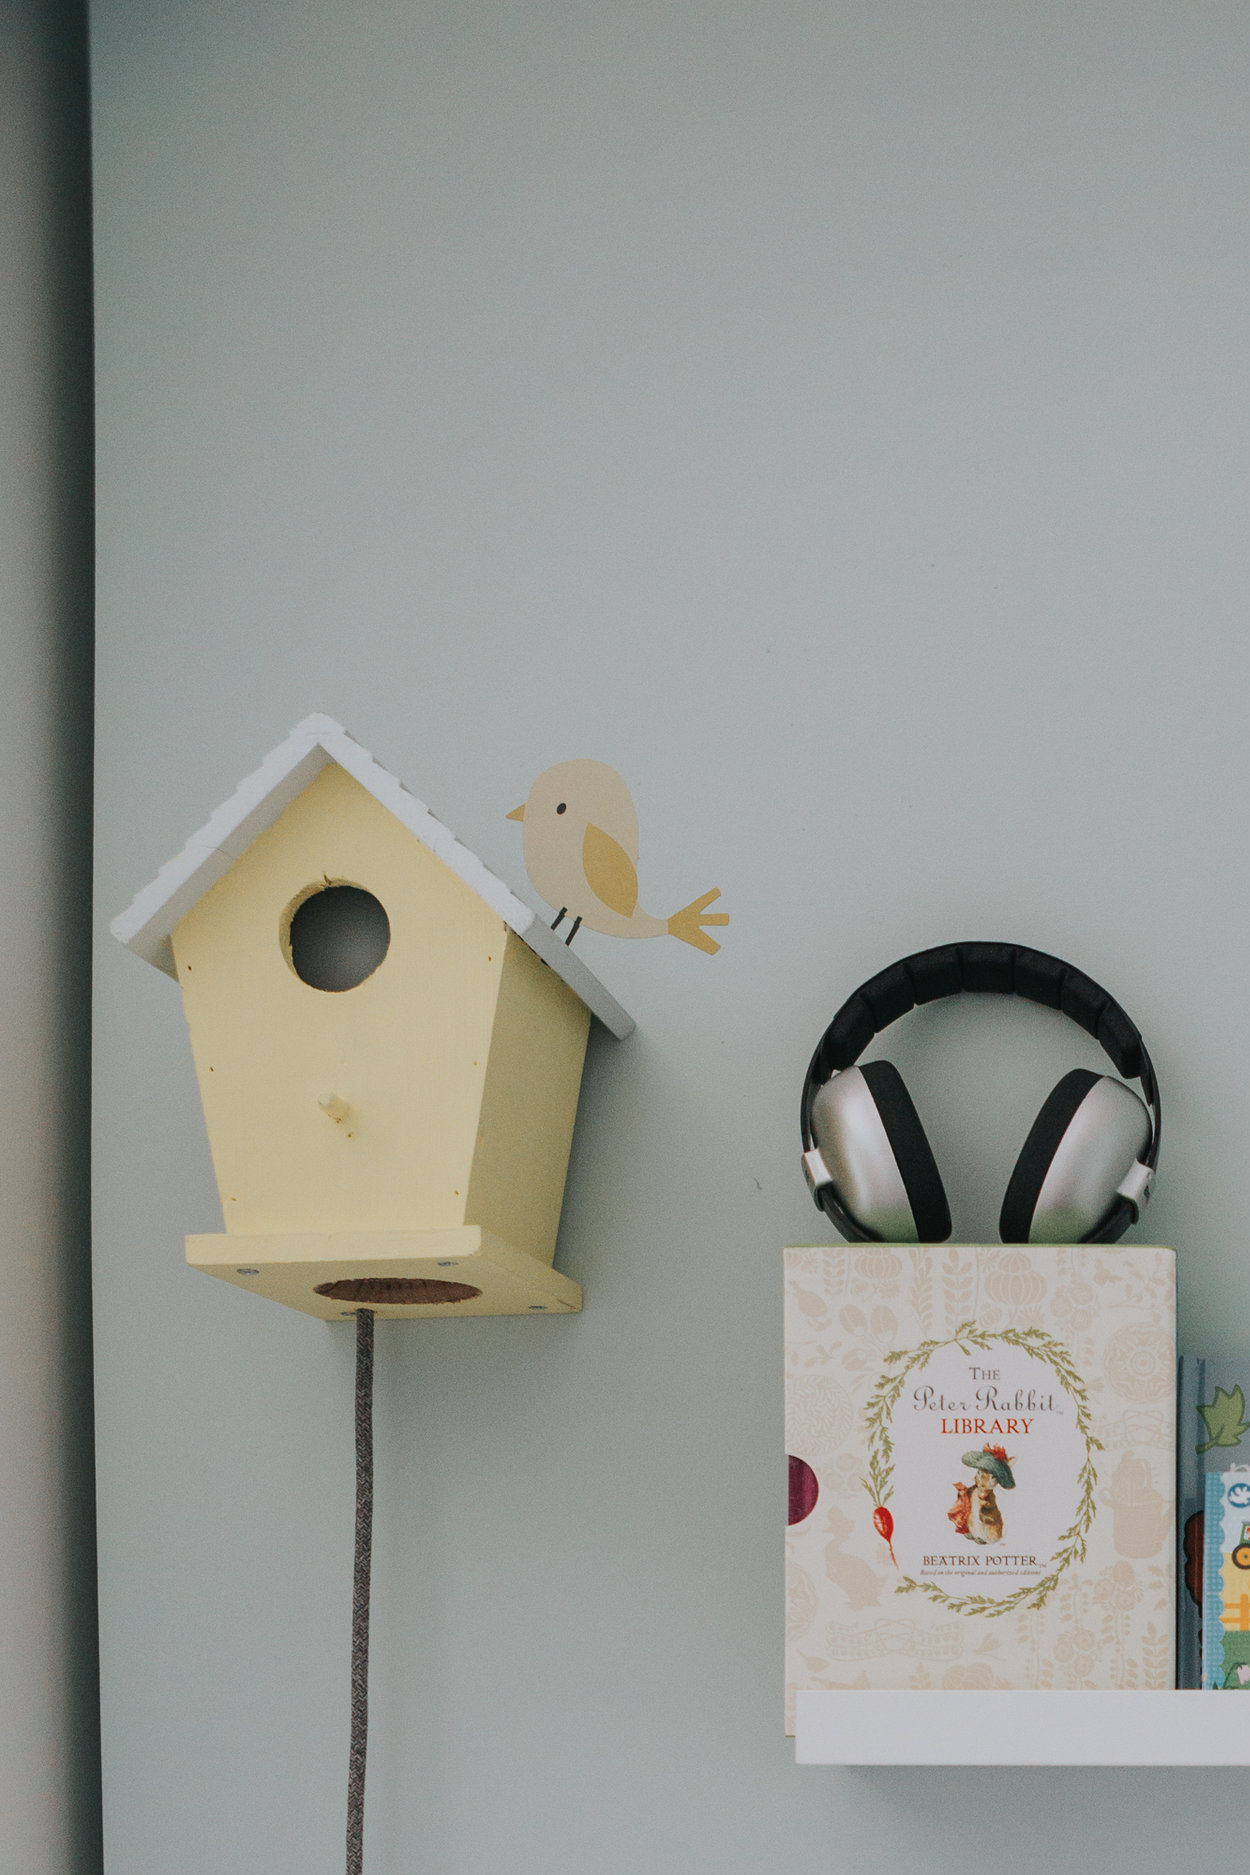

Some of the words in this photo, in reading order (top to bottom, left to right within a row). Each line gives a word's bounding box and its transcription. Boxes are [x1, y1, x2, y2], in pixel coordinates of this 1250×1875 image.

[969, 1367, 1000, 1380] THE
[913, 1385, 969, 1412] Peter
[975, 1385, 1057, 1412] Rabbit
[941, 1418, 1034, 1434] LIBRARY
[923, 1555, 980, 1566] BEATRIX
[985, 1555, 1037, 1566] POTTER
